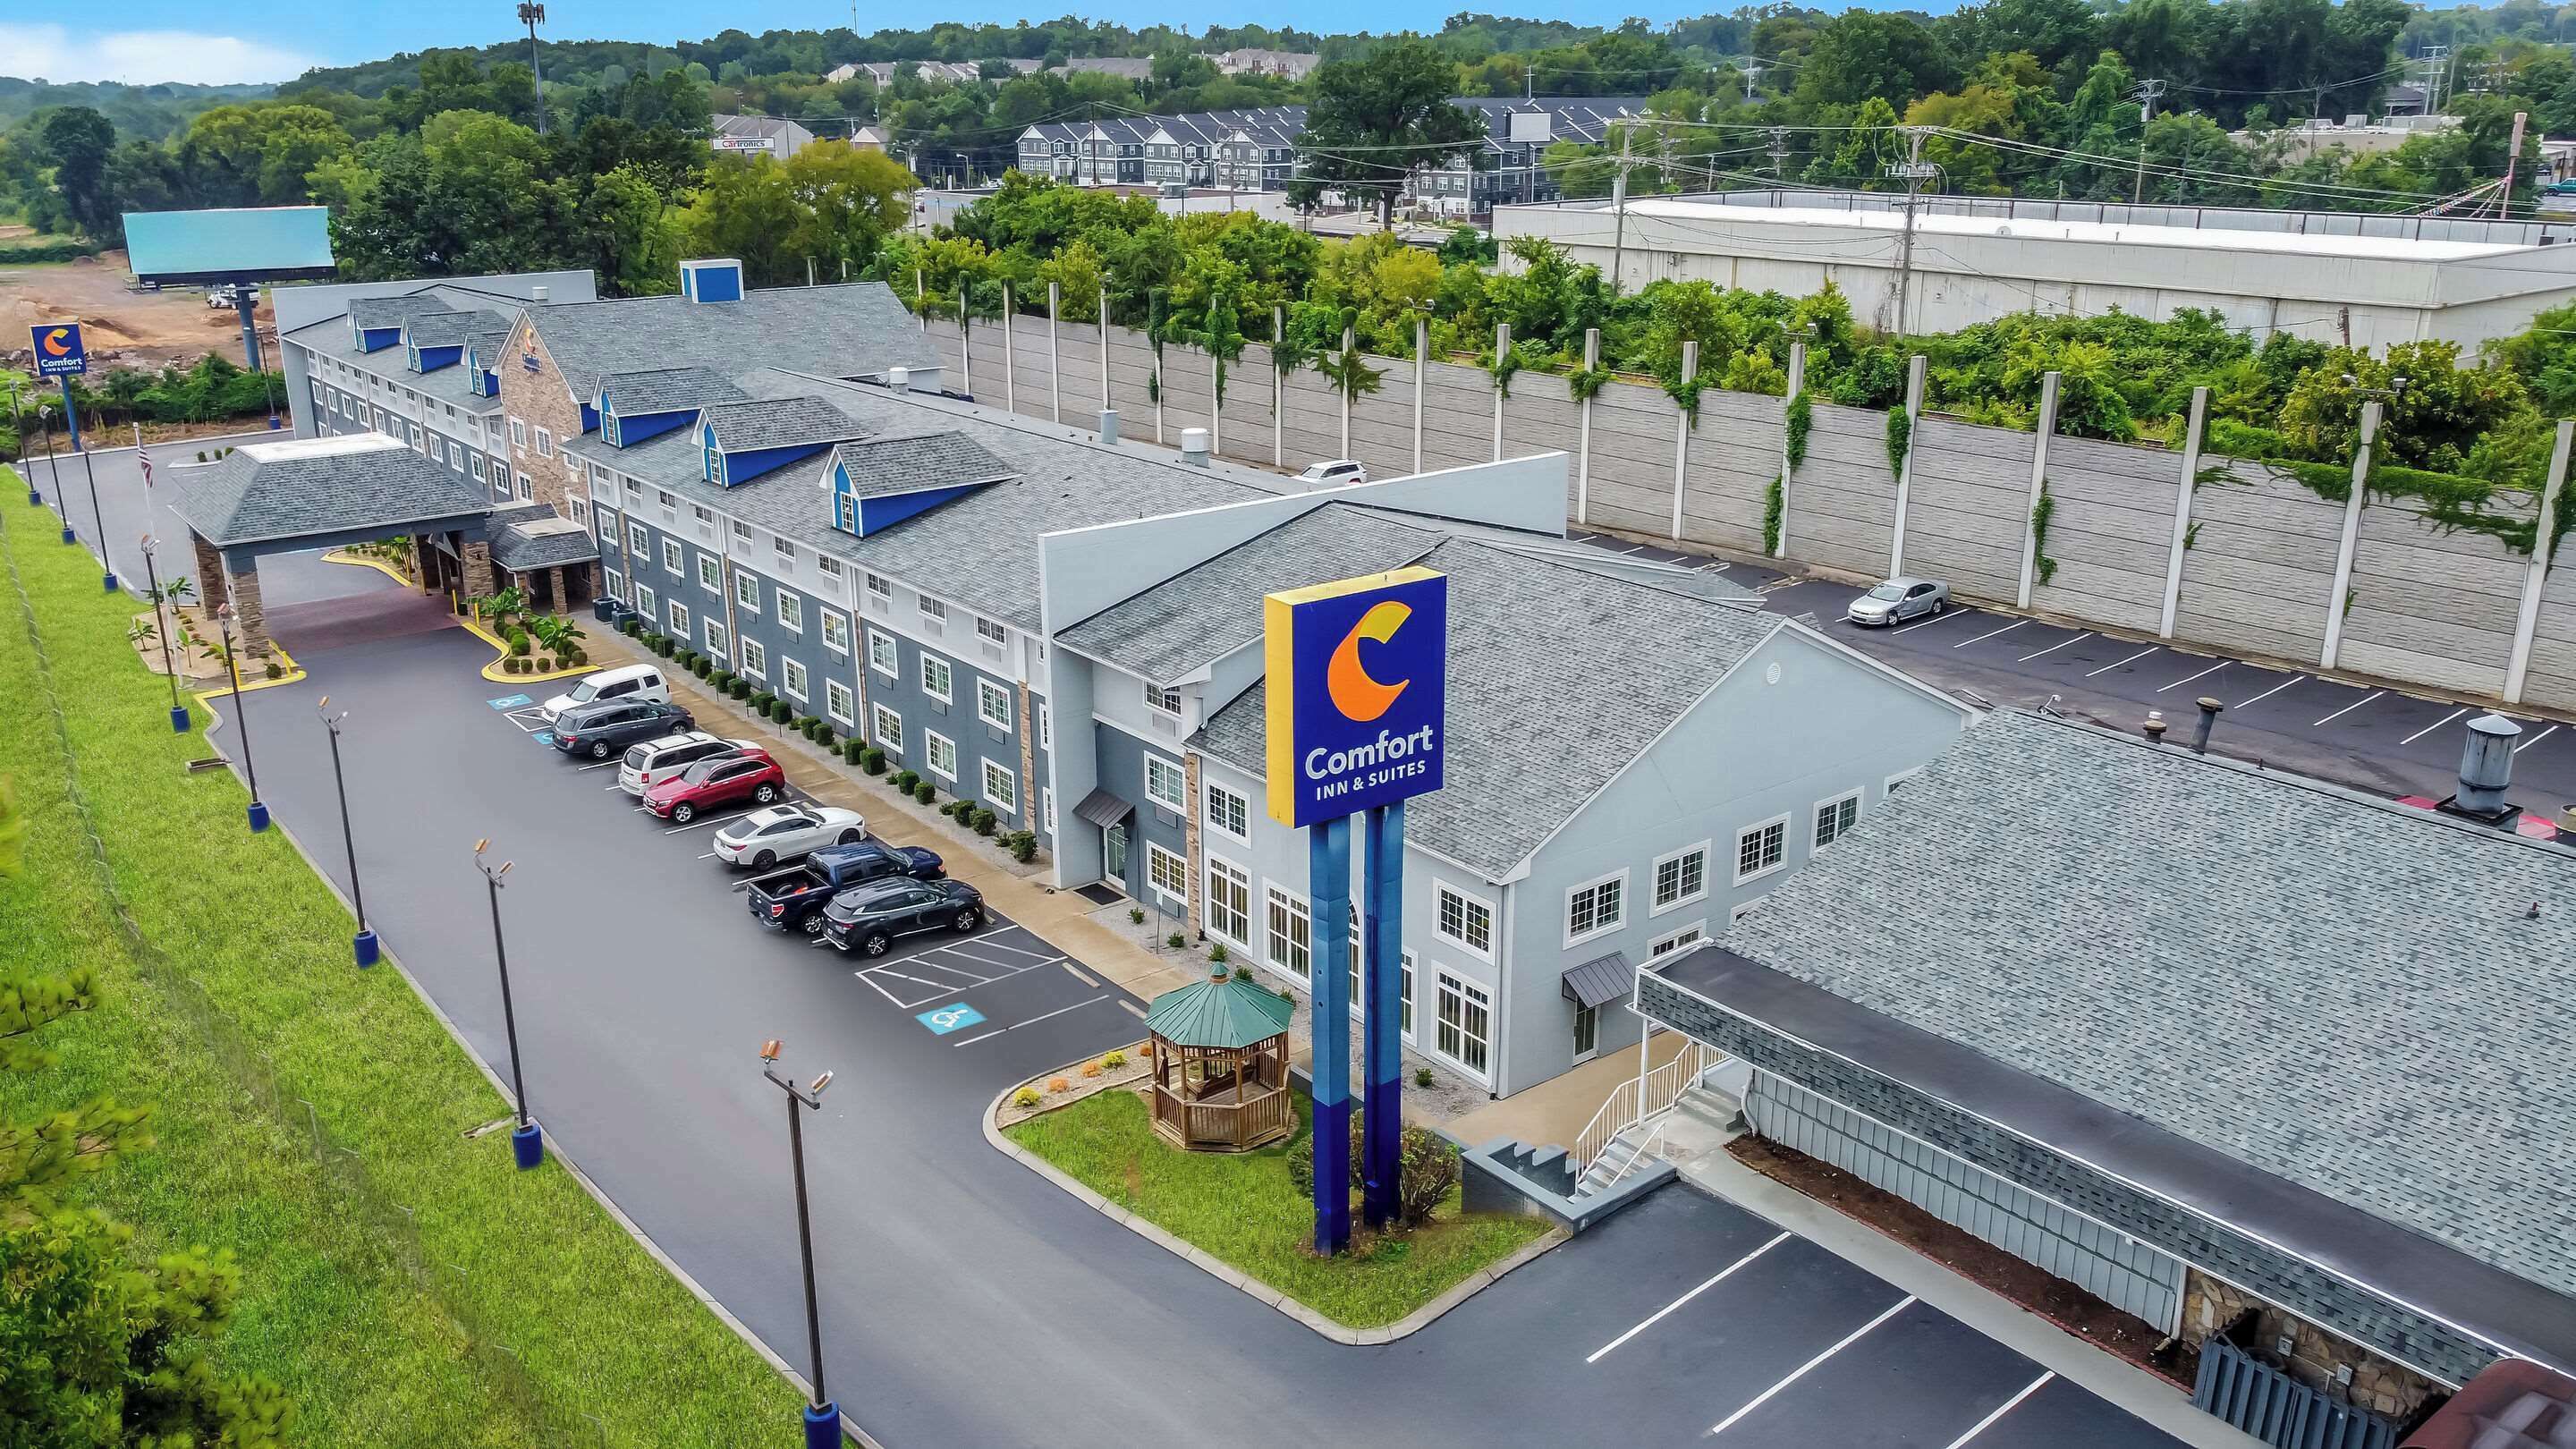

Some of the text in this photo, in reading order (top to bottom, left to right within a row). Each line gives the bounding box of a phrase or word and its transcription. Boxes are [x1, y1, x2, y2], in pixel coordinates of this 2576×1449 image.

[41, 358, 82, 367] Comfort
[1305, 724, 1433, 780] Comfort
[1317, 759, 1426, 801] INN & SUITES
